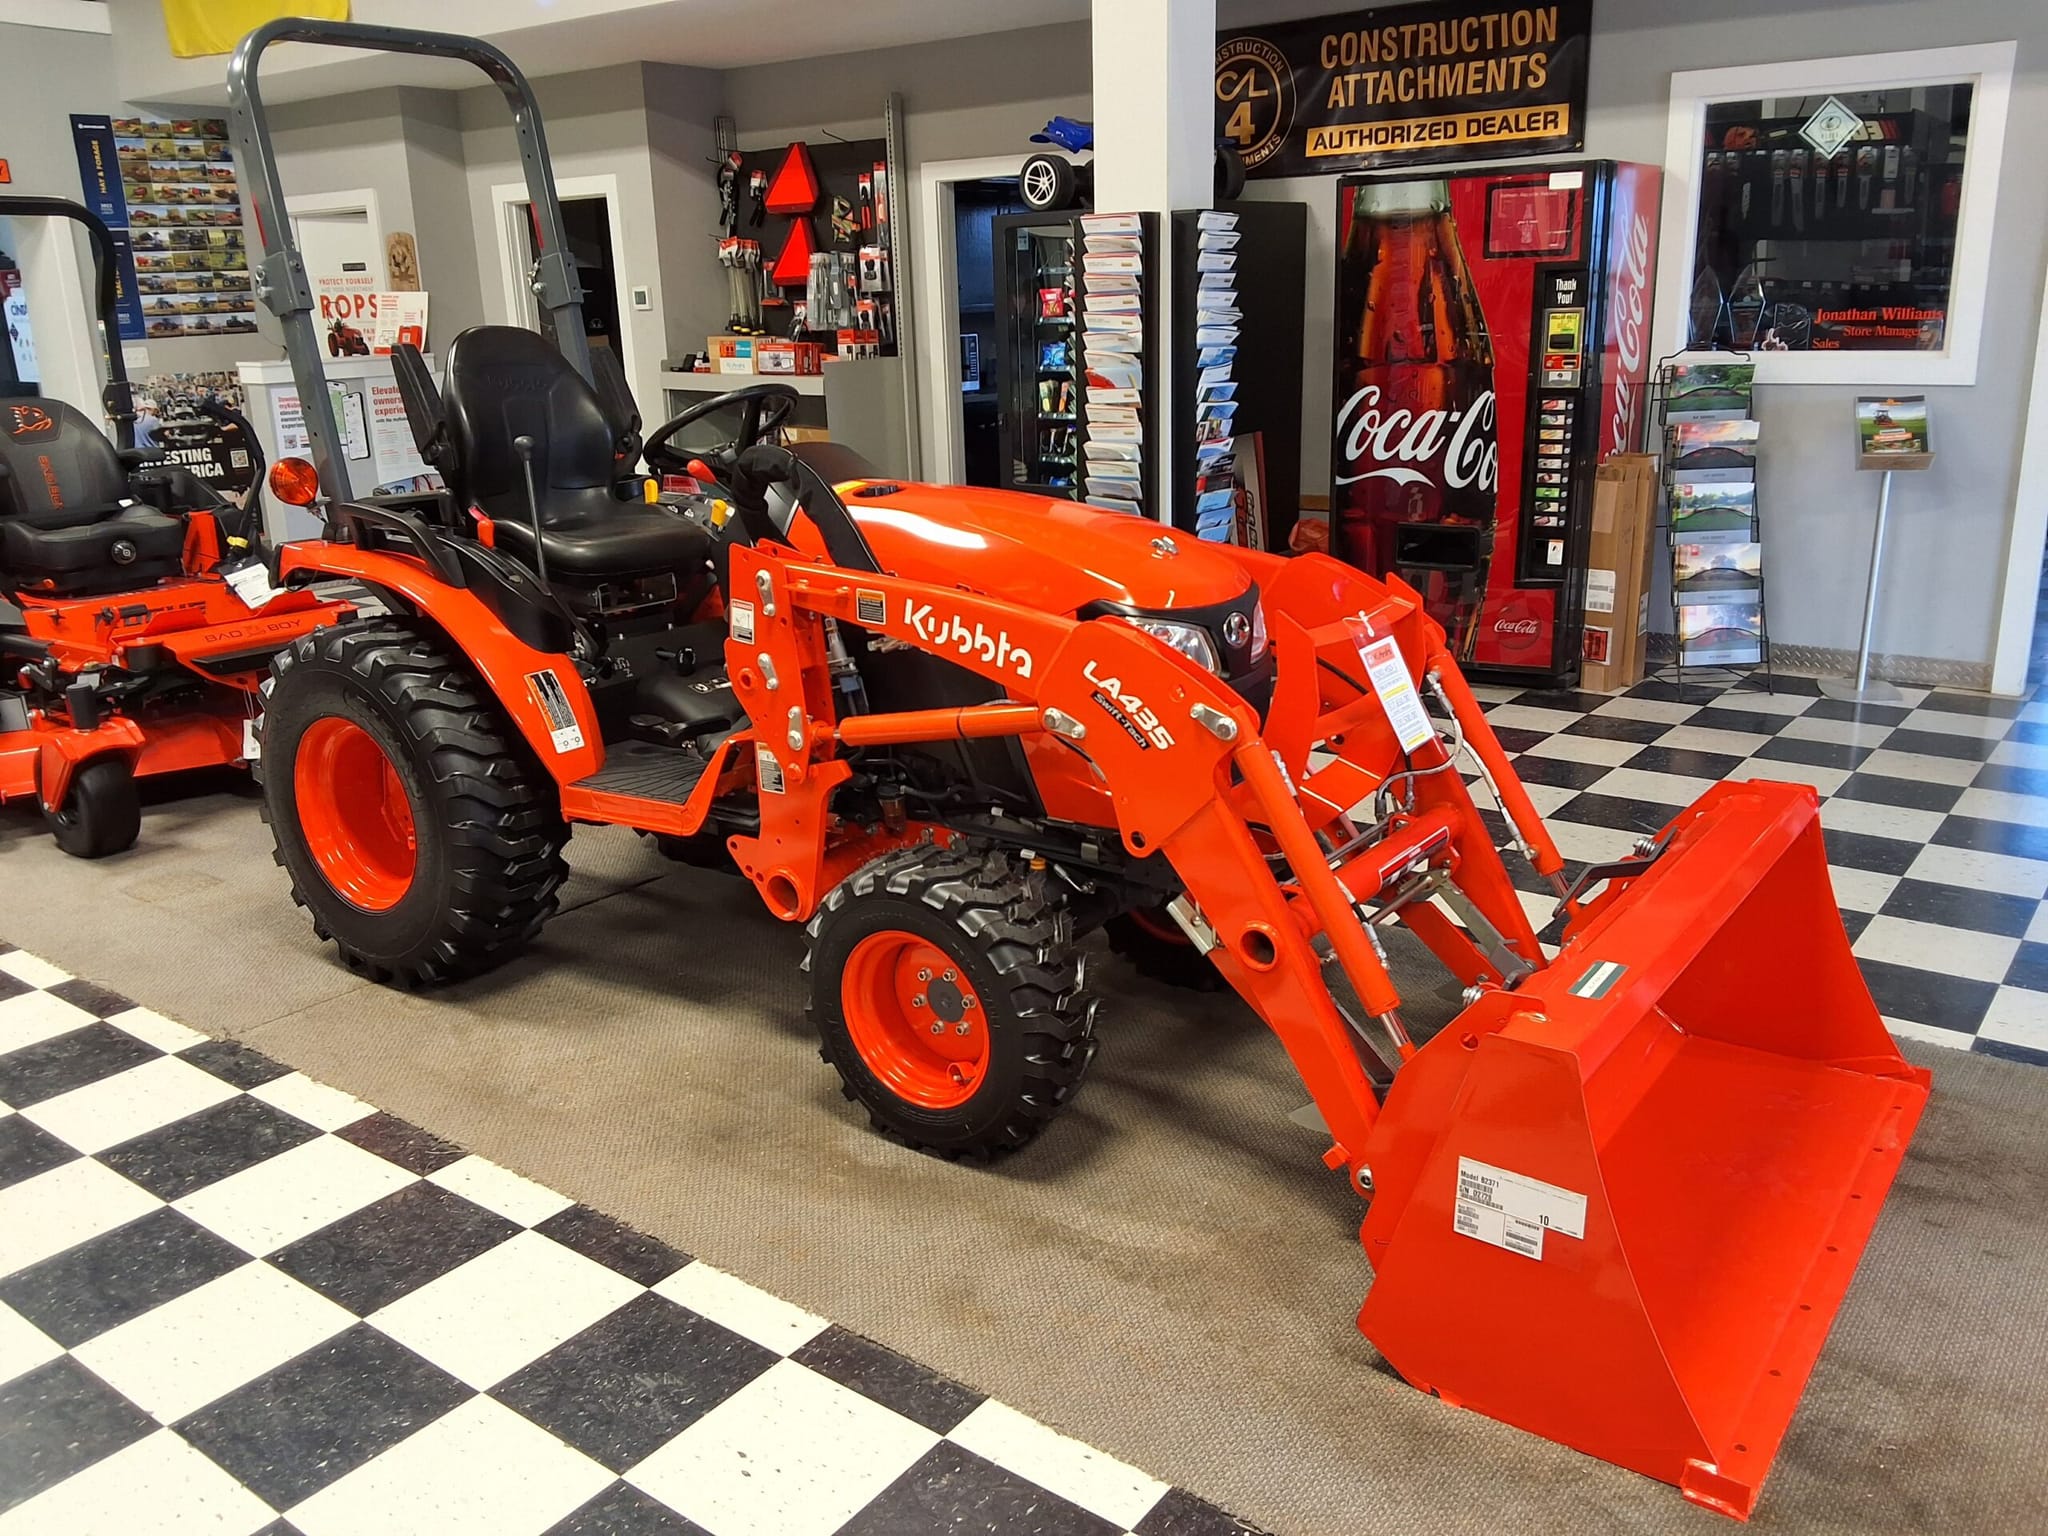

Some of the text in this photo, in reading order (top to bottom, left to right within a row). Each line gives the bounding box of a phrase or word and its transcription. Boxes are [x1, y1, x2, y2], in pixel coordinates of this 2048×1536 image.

[1320, 6, 1558, 70] CONSTRUCTION
[1216, 41, 1284, 73] NSTRUCTION
[1327, 52, 1548, 110] ATTACHMENTS
[1224, 100, 1255, 145] 4
[1312, 110, 1559, 150] AUTHORIZED DEALER
[1555, 278, 1577, 291] Thank
[320, 293, 377, 319] ROPS
[1557, 291, 1573, 305] You!
[1814, 307, 1945, 325] Jonathan Williams
[1812, 338, 1840, 349] Sales
[1843, 325, 1922, 339] Store Manager
[373, 397, 402, 405] owners
[374, 407, 404, 416] experie
[204, 619, 301, 643] BAD BOY
[903, 598, 1033, 678] Kubota
[1082, 660, 1175, 750] LA435
[1093, 692, 1148, 749] Swift-Tach
[1460, 1170, 1479, 1181] Model
[1538, 1214, 1550, 1226] 10
